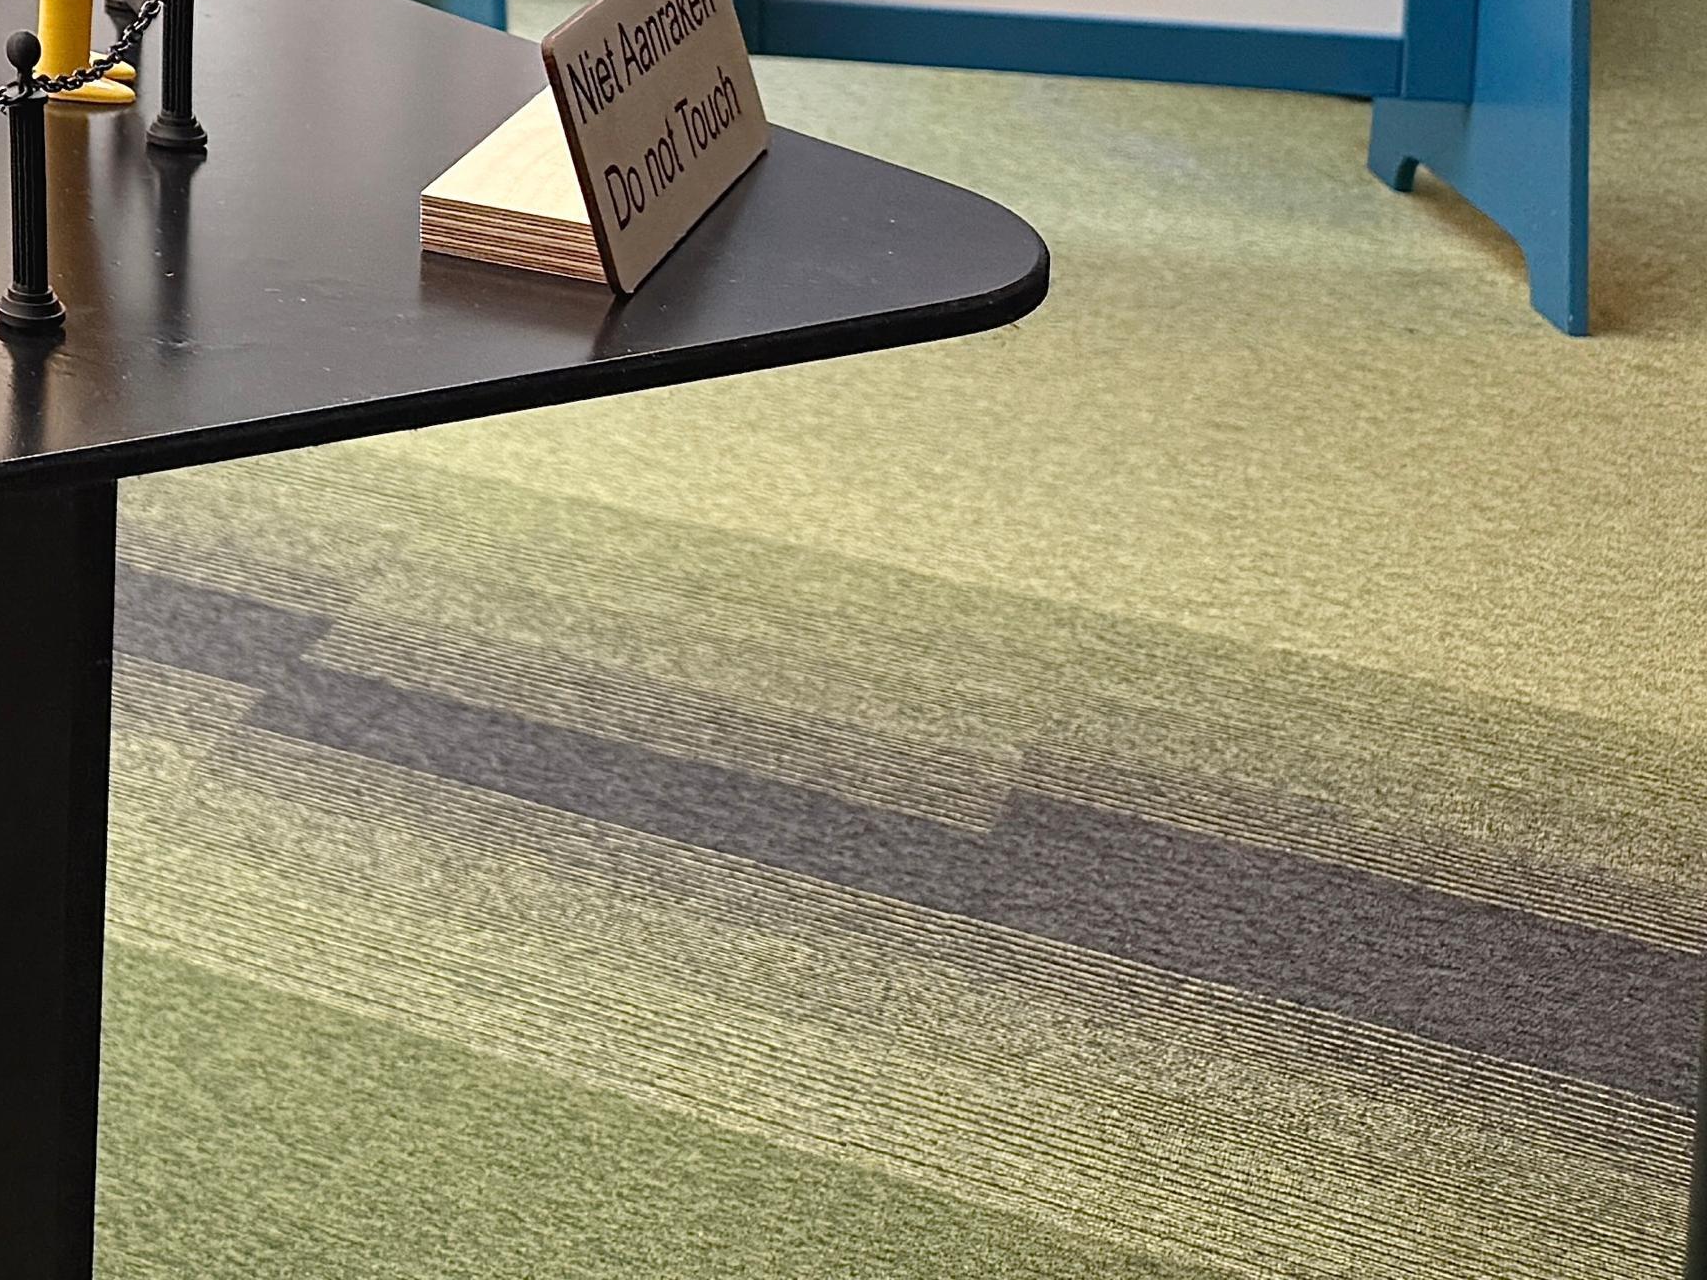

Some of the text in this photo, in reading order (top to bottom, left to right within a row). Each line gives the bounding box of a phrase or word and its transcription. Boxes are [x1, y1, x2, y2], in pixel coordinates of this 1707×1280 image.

[567, 37, 625, 125] Niet
[604, 65, 742, 232] Do not Touch
